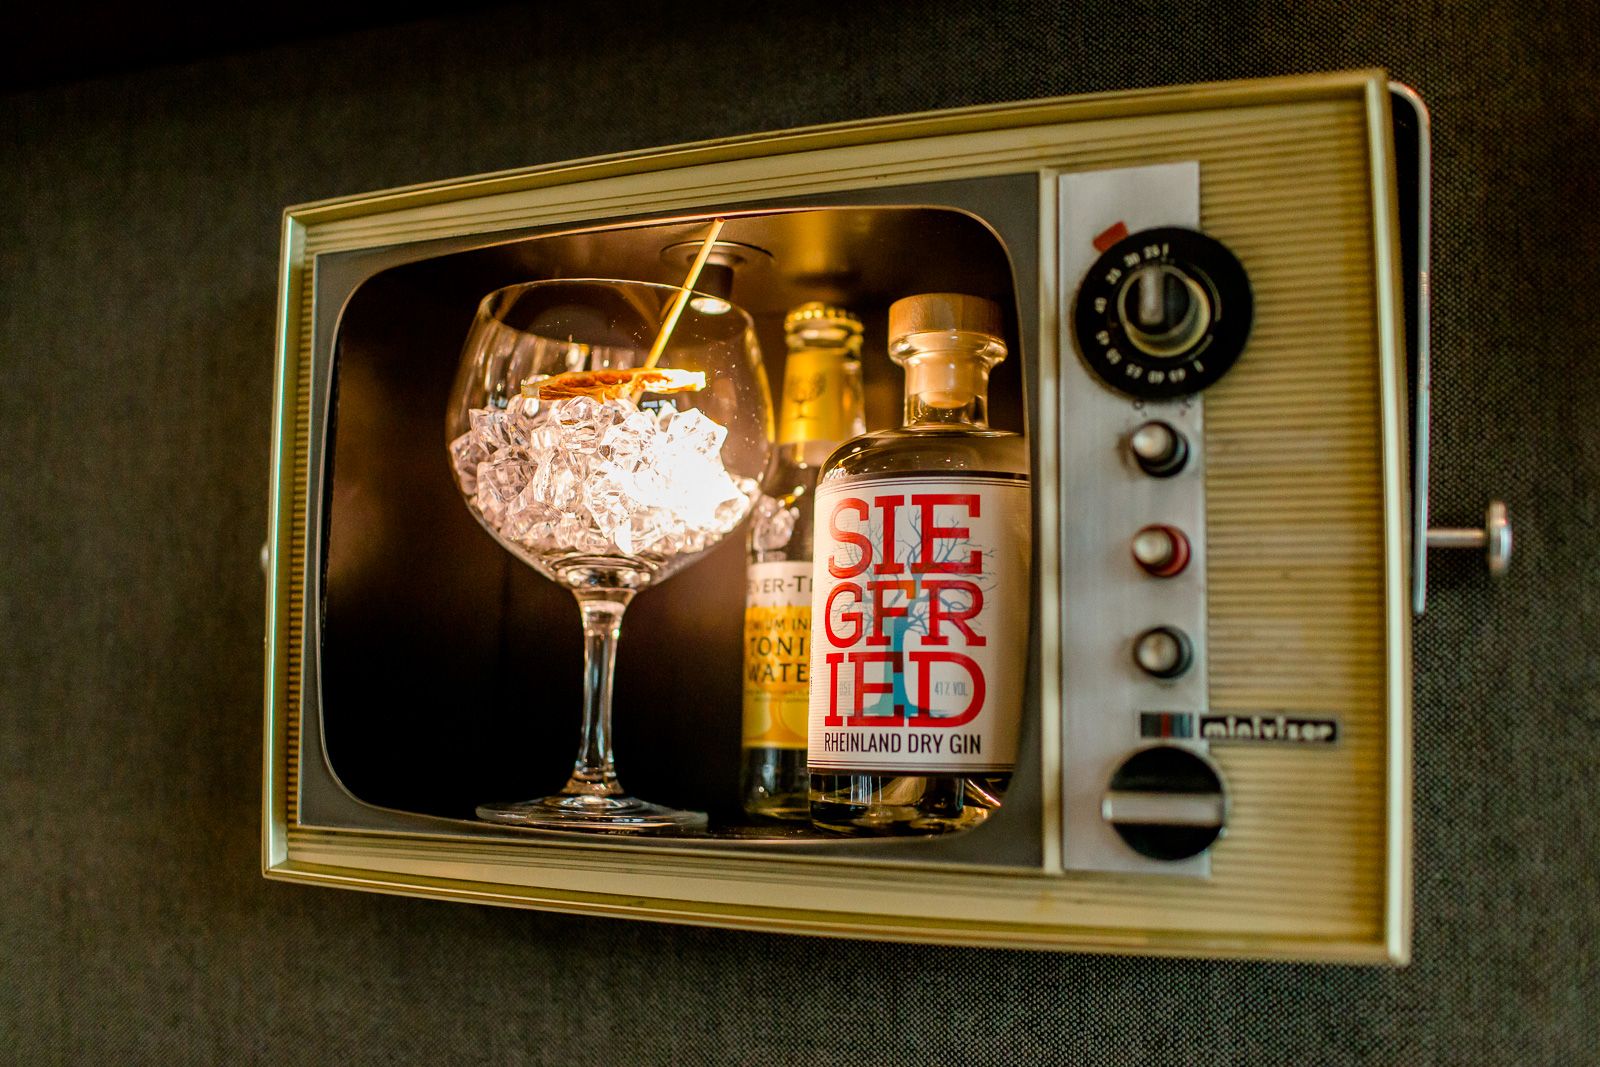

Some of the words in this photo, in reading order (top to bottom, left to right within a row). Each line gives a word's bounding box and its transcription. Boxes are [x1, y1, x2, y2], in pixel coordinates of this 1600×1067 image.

[828, 493, 983, 579] SIE
[824, 580, 987, 648] GFR
[750, 636, 805, 656] TONI
[748, 663, 808, 683] WATE
[824, 651, 986, 728] IED
[824, 732, 902, 753] RHEINLAND
[908, 733, 944, 754] DRY
[950, 734, 981, 754] GIN
